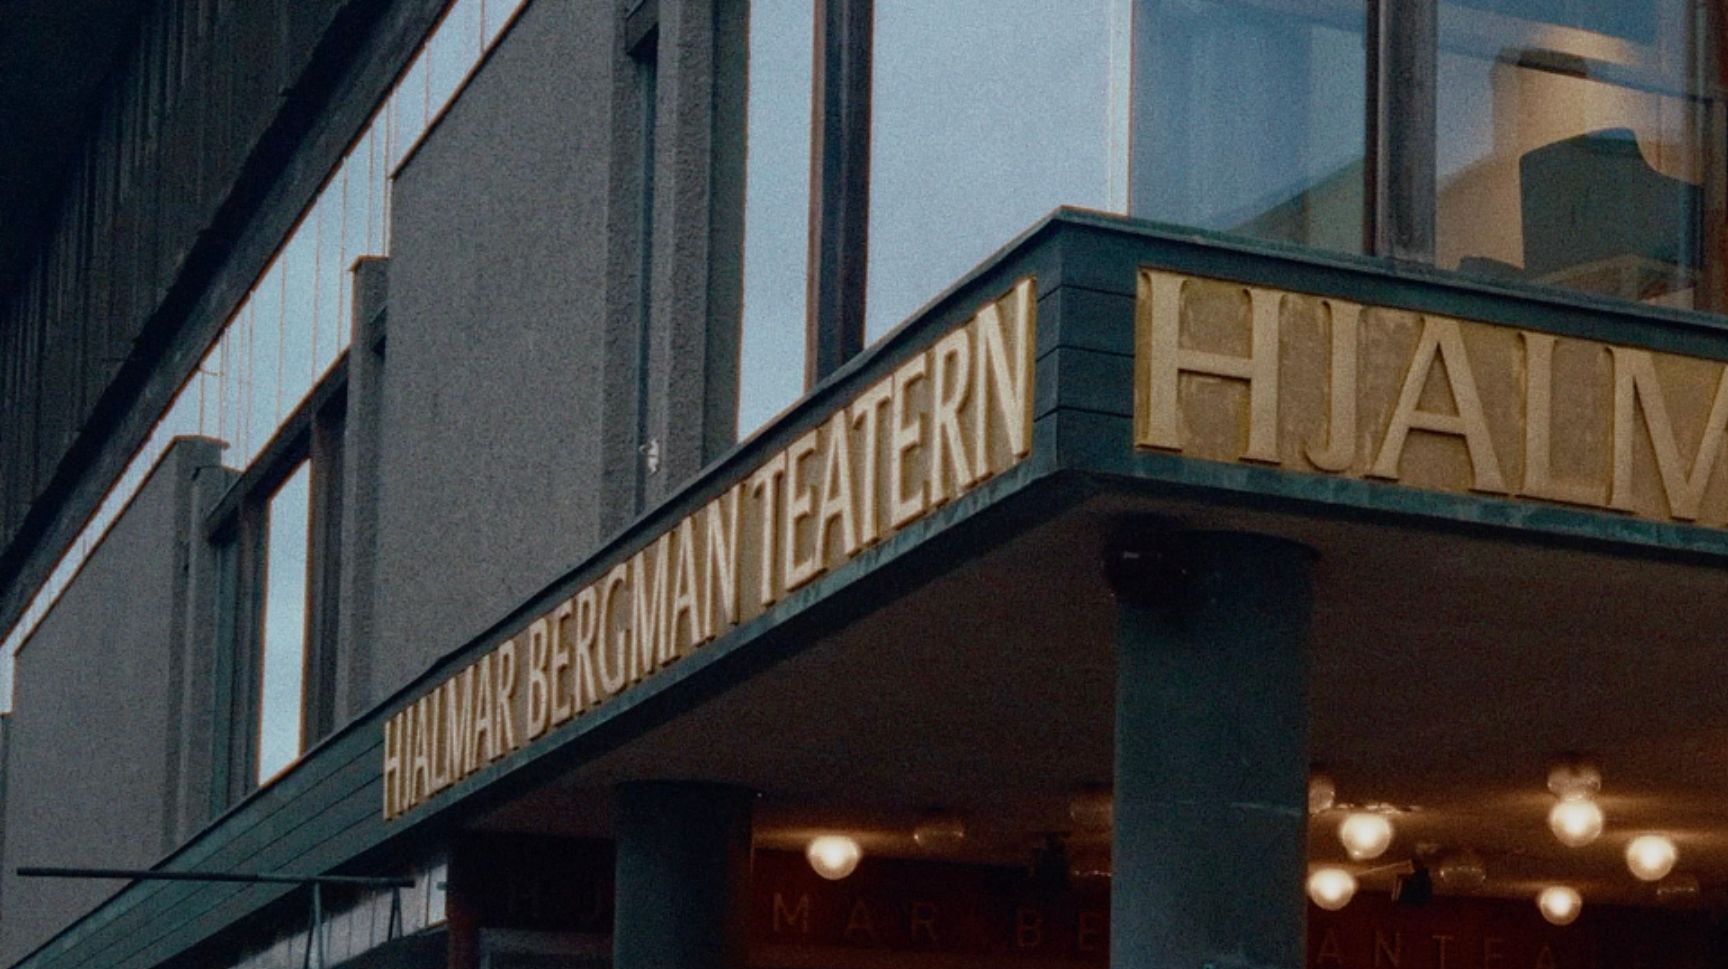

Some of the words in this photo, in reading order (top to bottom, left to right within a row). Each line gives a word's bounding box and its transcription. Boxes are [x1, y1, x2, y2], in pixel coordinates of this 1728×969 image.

[383, 638, 518, 821] HJALMAR
[525, 482, 748, 740] BERGMAN
[753, 276, 1038, 607] TEATERN
